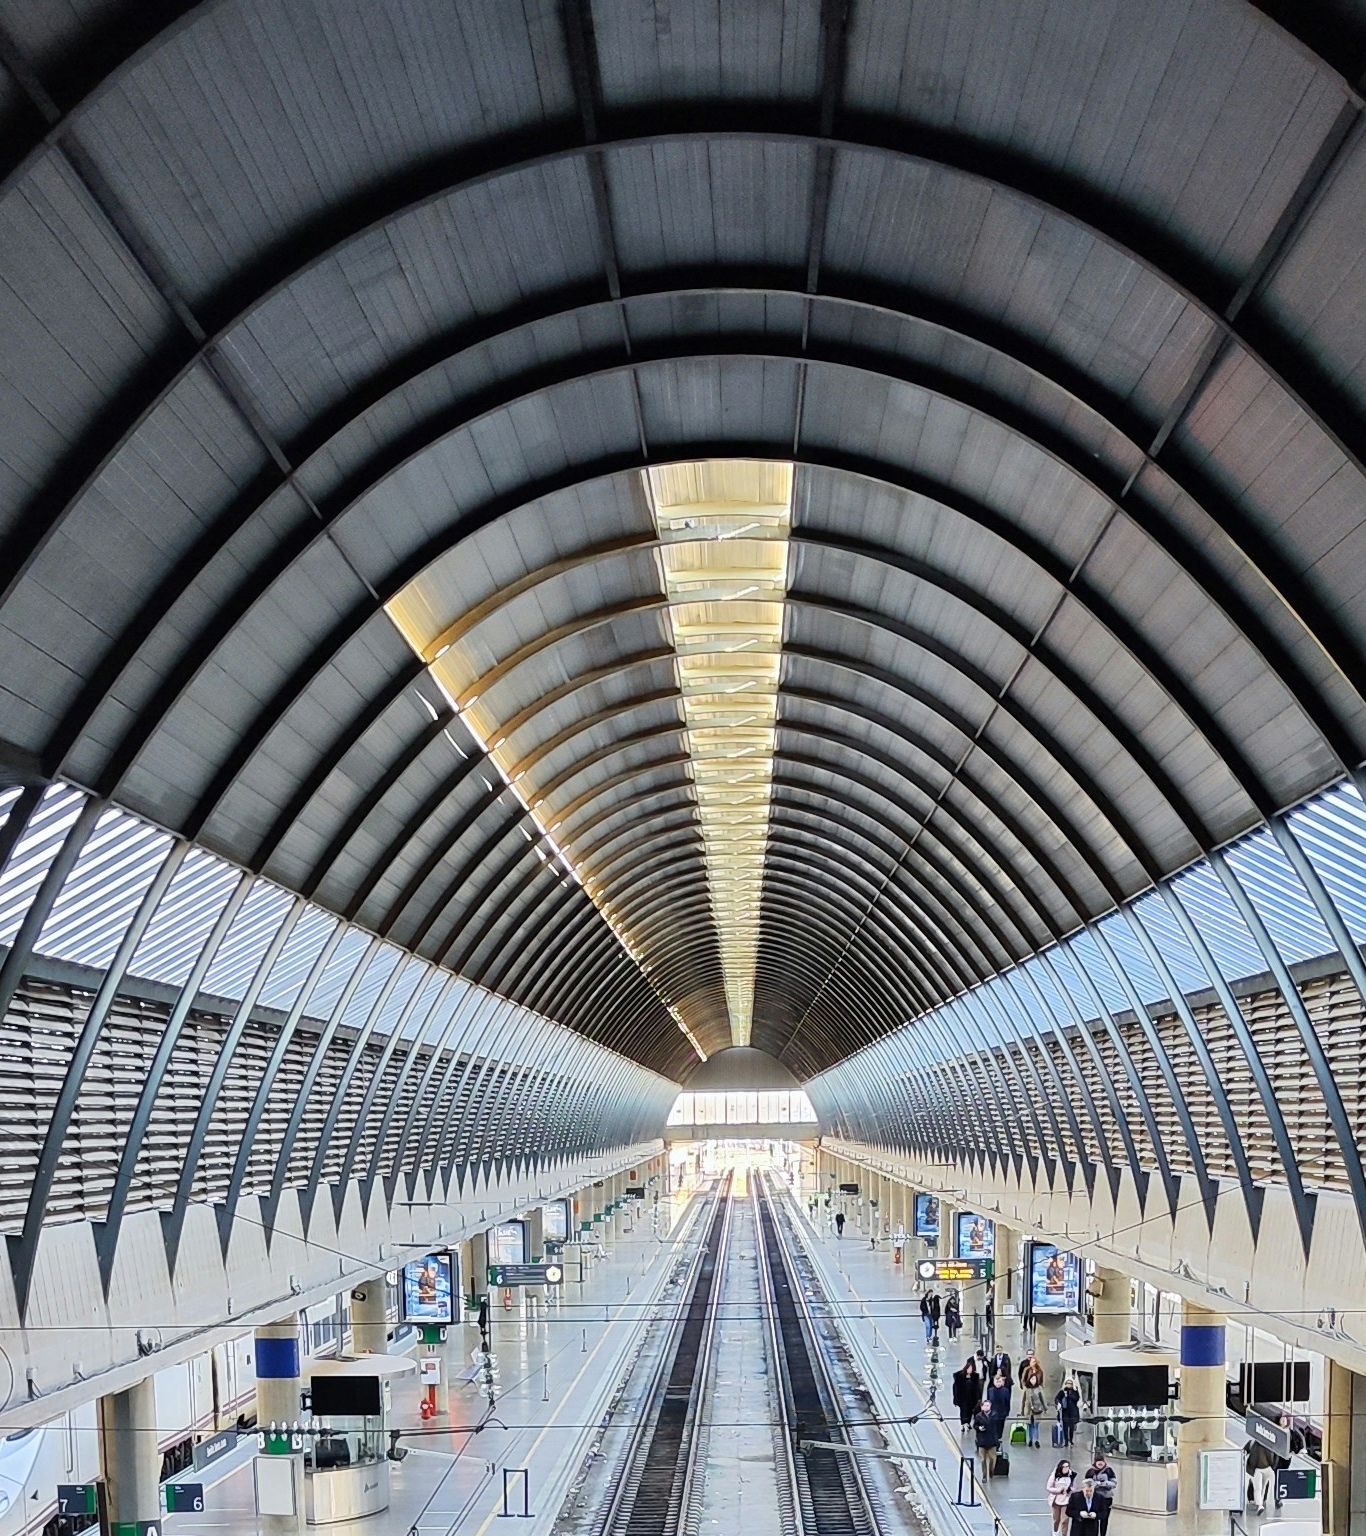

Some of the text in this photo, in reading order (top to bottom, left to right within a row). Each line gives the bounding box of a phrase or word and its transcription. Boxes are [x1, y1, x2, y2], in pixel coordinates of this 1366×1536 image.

[1279, 1484, 1288, 1498] 5
[59, 1499, 68, 1513] 7
[193, 1496, 203, 1511] 6
